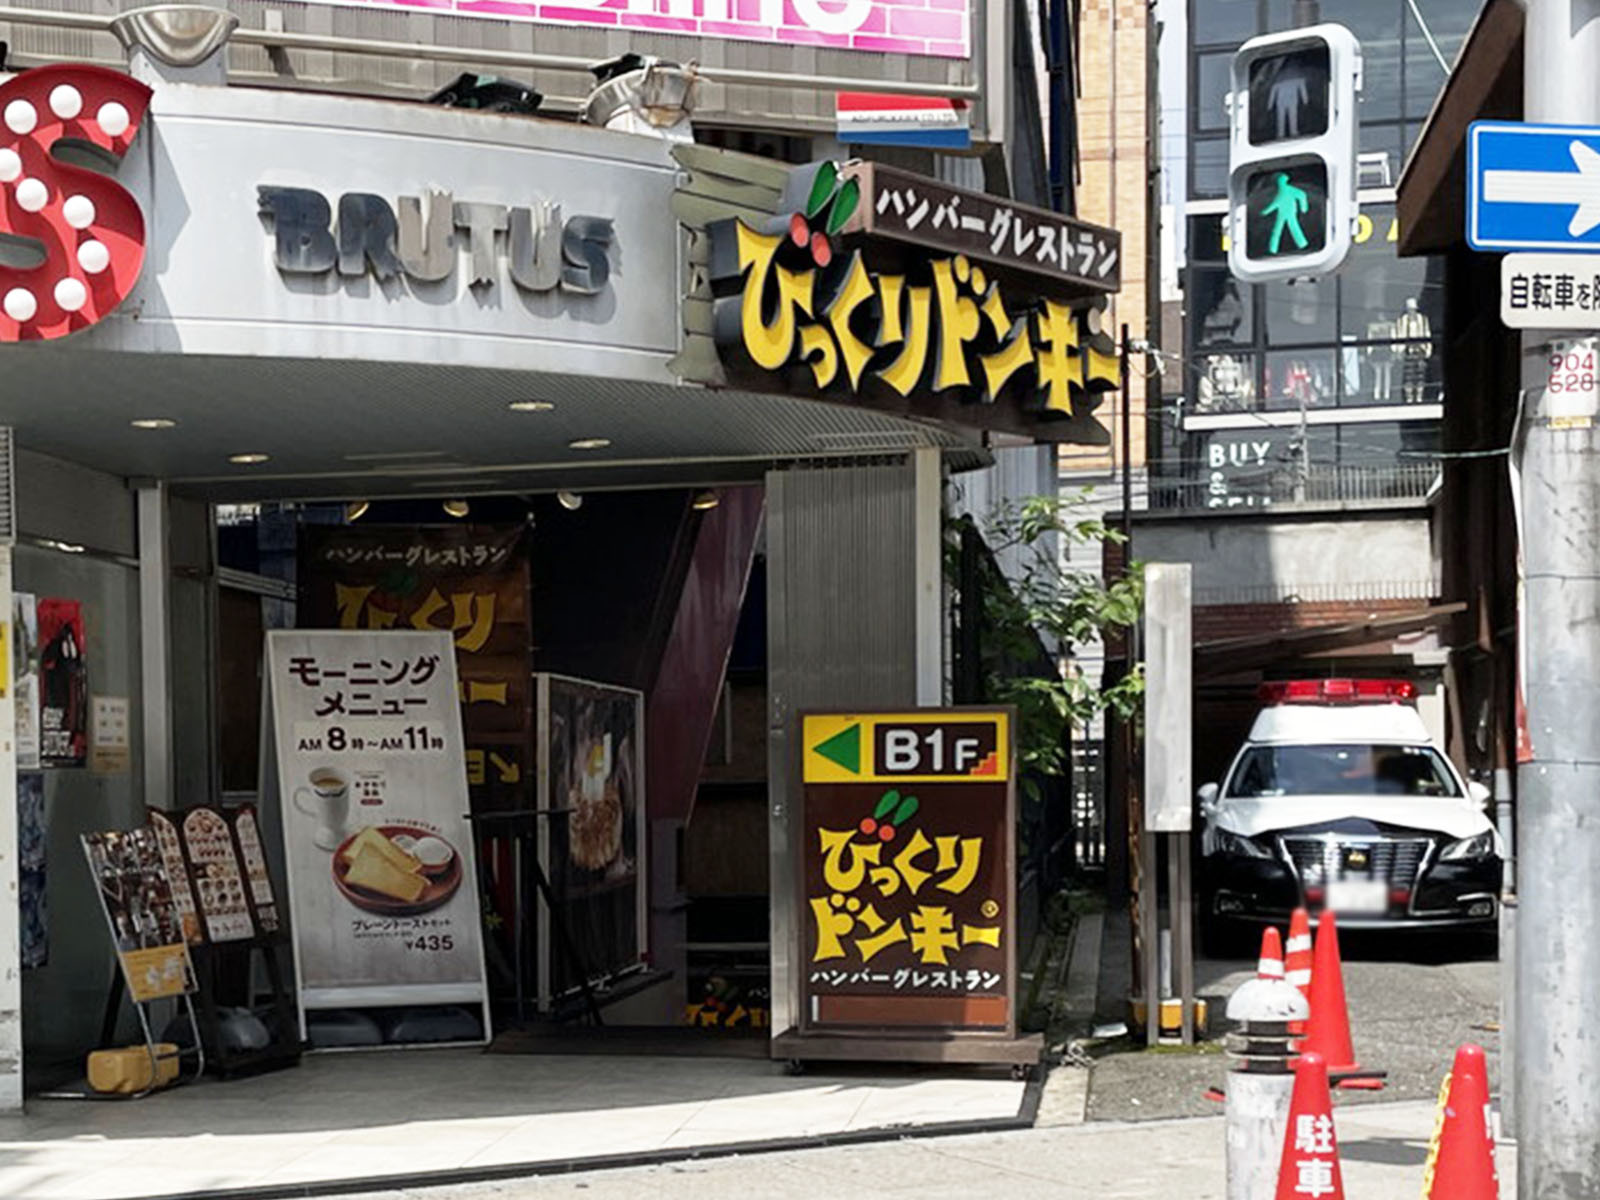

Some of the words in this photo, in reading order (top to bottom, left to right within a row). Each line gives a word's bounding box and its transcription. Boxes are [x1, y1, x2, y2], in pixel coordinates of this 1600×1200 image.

[257, 184, 621, 297] BRUTUS
[875, 187, 1118, 278] ハンバーグレストラン
[735, 216, 1121, 417] びっくりドンキー
[1549, 353, 1593, 371] 904
[1209, 441, 1270, 468] BUY
[325, 544, 508, 568] ハンバーグレストラン
[288, 653, 441, 687] モーニング
[314, 690, 428, 717] メニュー
[884, 727, 980, 772] B1F
[818, 827, 983, 897] びっくり
[405, 935, 454, 951] ¥435
[809, 892, 1001, 966] ドンキー
[810, 967, 1001, 991] ハンバーグレストラン
